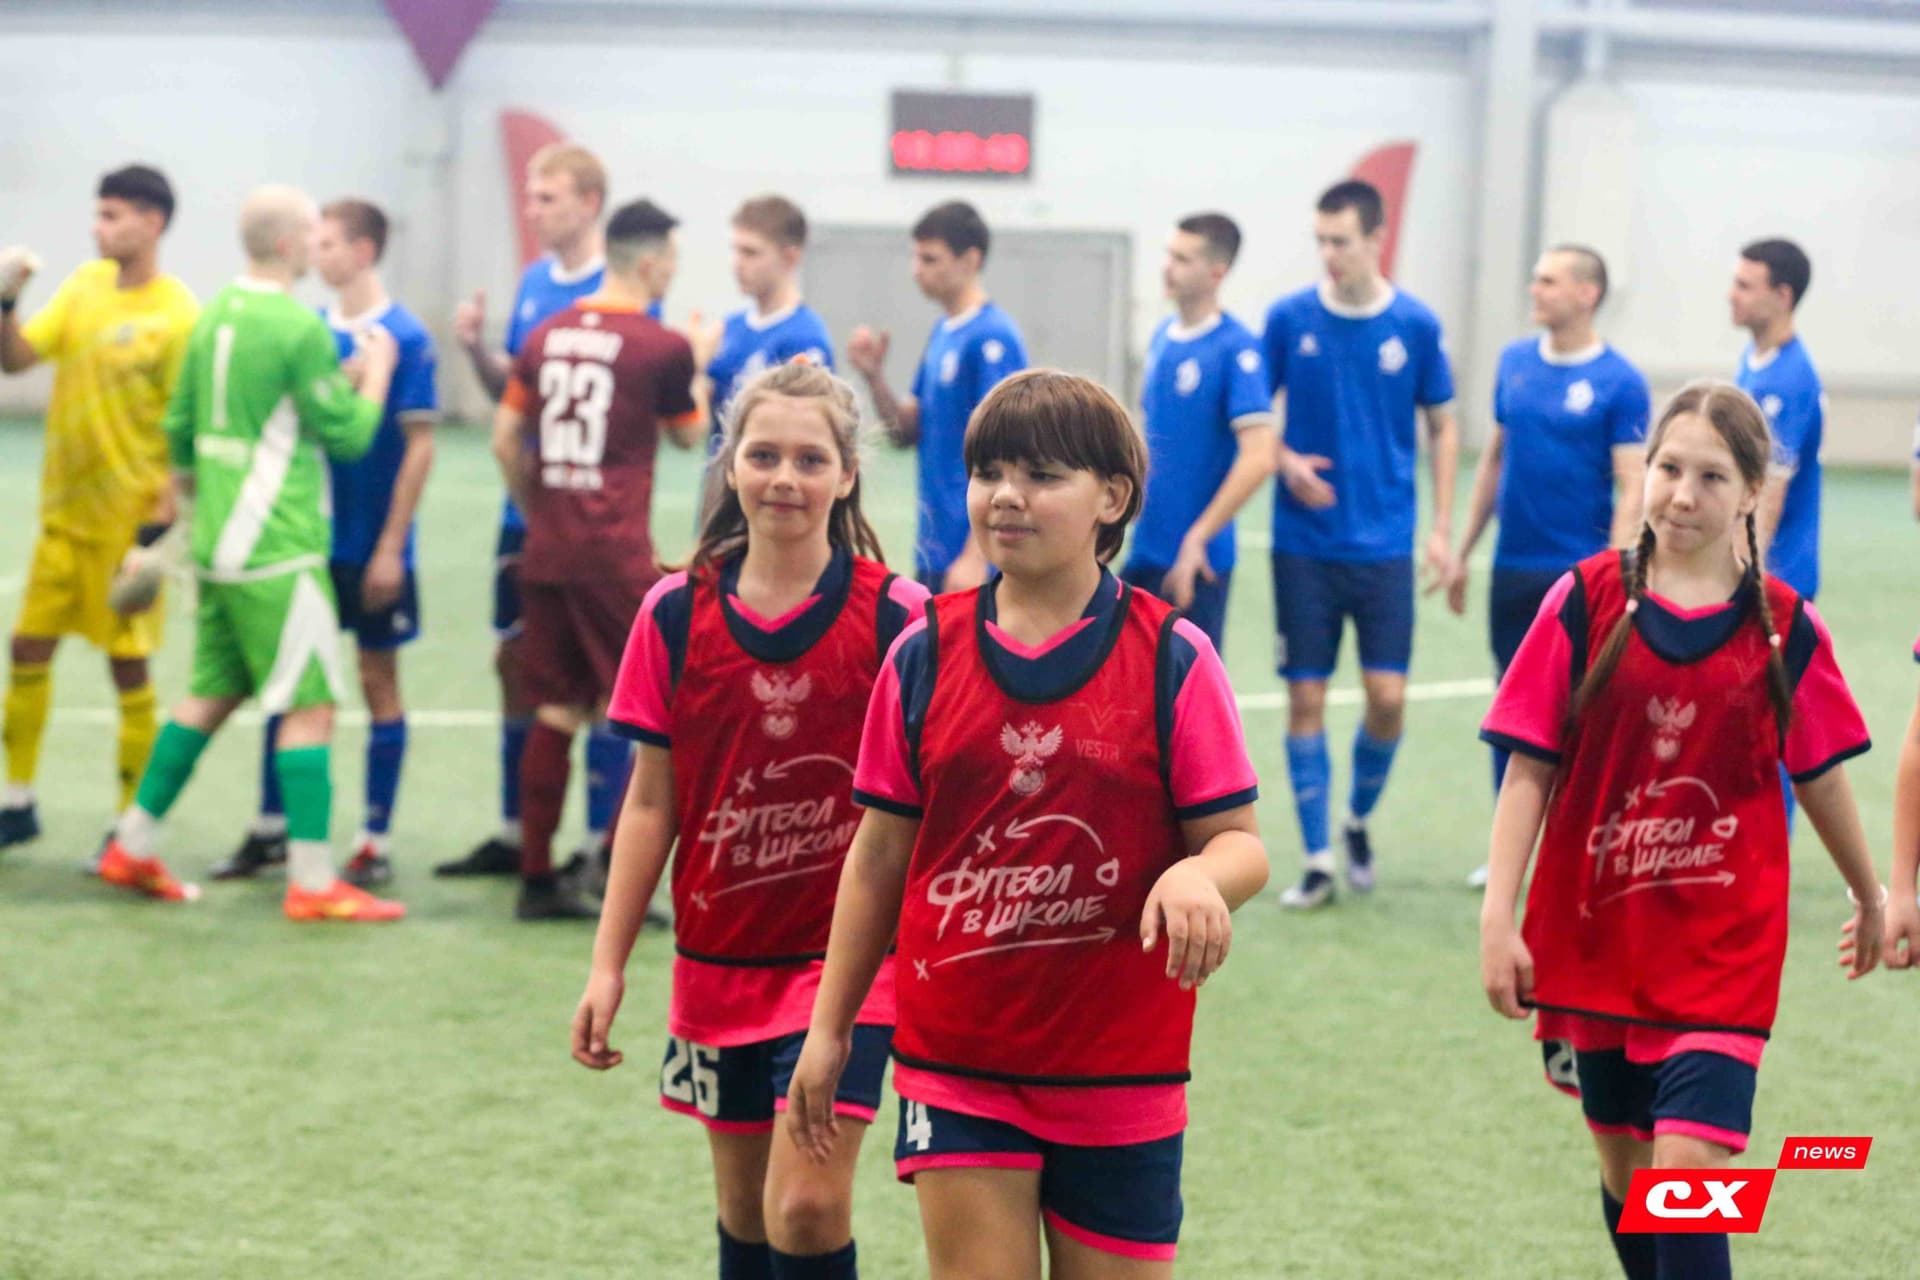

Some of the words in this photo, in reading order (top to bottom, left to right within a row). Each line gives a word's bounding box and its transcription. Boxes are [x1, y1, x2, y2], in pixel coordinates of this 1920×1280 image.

[538, 359, 616, 464] 23
[698, 796, 836, 873] ФУТБОЛ
[1587, 811, 1696, 884] ФУТБОЛ
[1631, 843, 1726, 878] ШКОЛЕ
[926, 856, 1075, 943] ФУТБОЛ
[984, 894, 1108, 938] ШКОЛЕ
[662, 1038, 719, 1118] 26
[906, 1100, 932, 1151] 4
